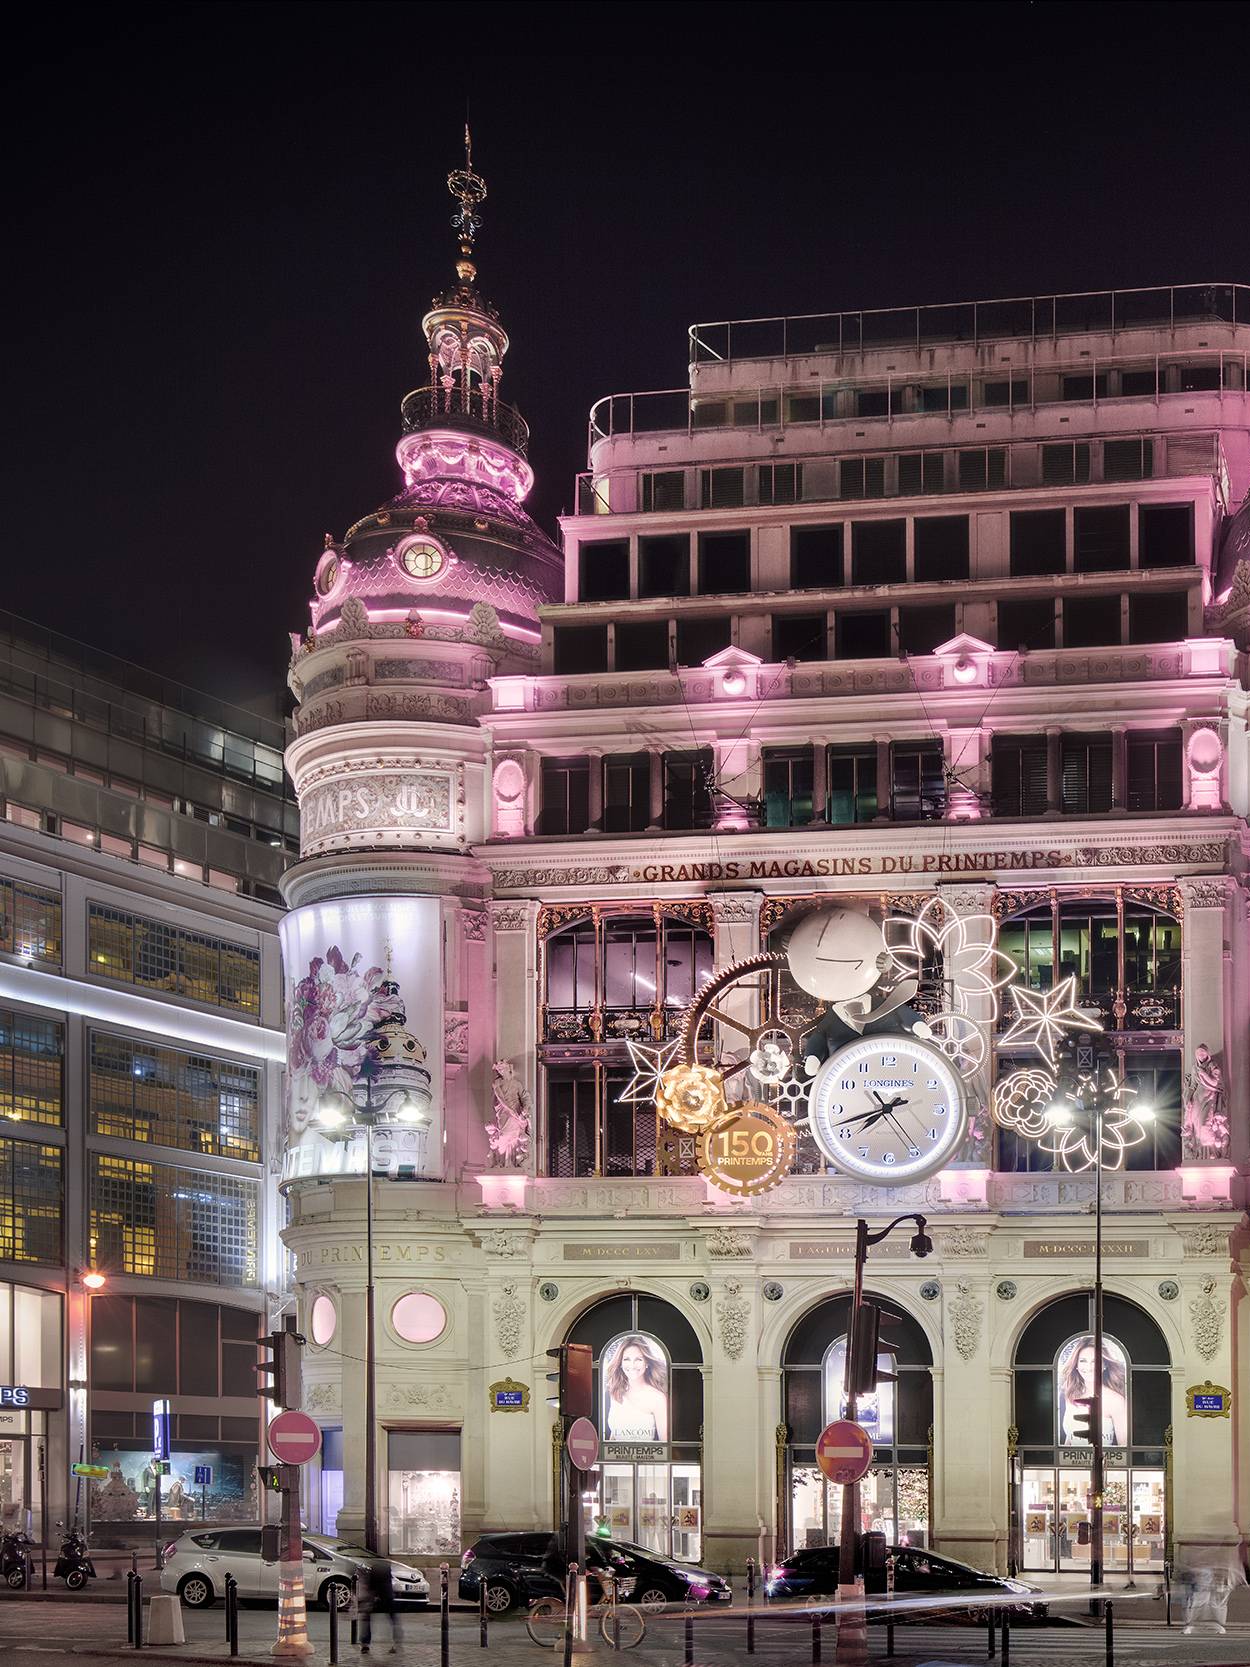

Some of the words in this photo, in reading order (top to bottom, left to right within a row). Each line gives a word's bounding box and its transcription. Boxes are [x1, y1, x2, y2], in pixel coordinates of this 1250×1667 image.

[643, 862, 740, 881] GRANDS
[750, 857, 872, 878] MAGASINS
[881, 855, 914, 873] DU
[923, 850, 1062, 872] PRINTEMPS
[881, 1056, 896, 1067] 12
[841, 1080, 856, 1090] 10
[864, 1079, 914, 1088] LONGINES
[927, 1080, 937, 1090] 2
[832, 1103, 843, 1115] 9
[839, 1128, 851, 1140] 8
[926, 1128, 937, 1140] 4
[718, 1130, 774, 1157] 150
[858, 1146, 869, 1157] 7
[717, 1157, 774, 1166] PRINTEMPS
[883, 1152, 895, 1164] 6
[608, 1446, 663, 1455] PRINTEMPS
[1063, 1451, 1123, 1460] PRINTMPS
